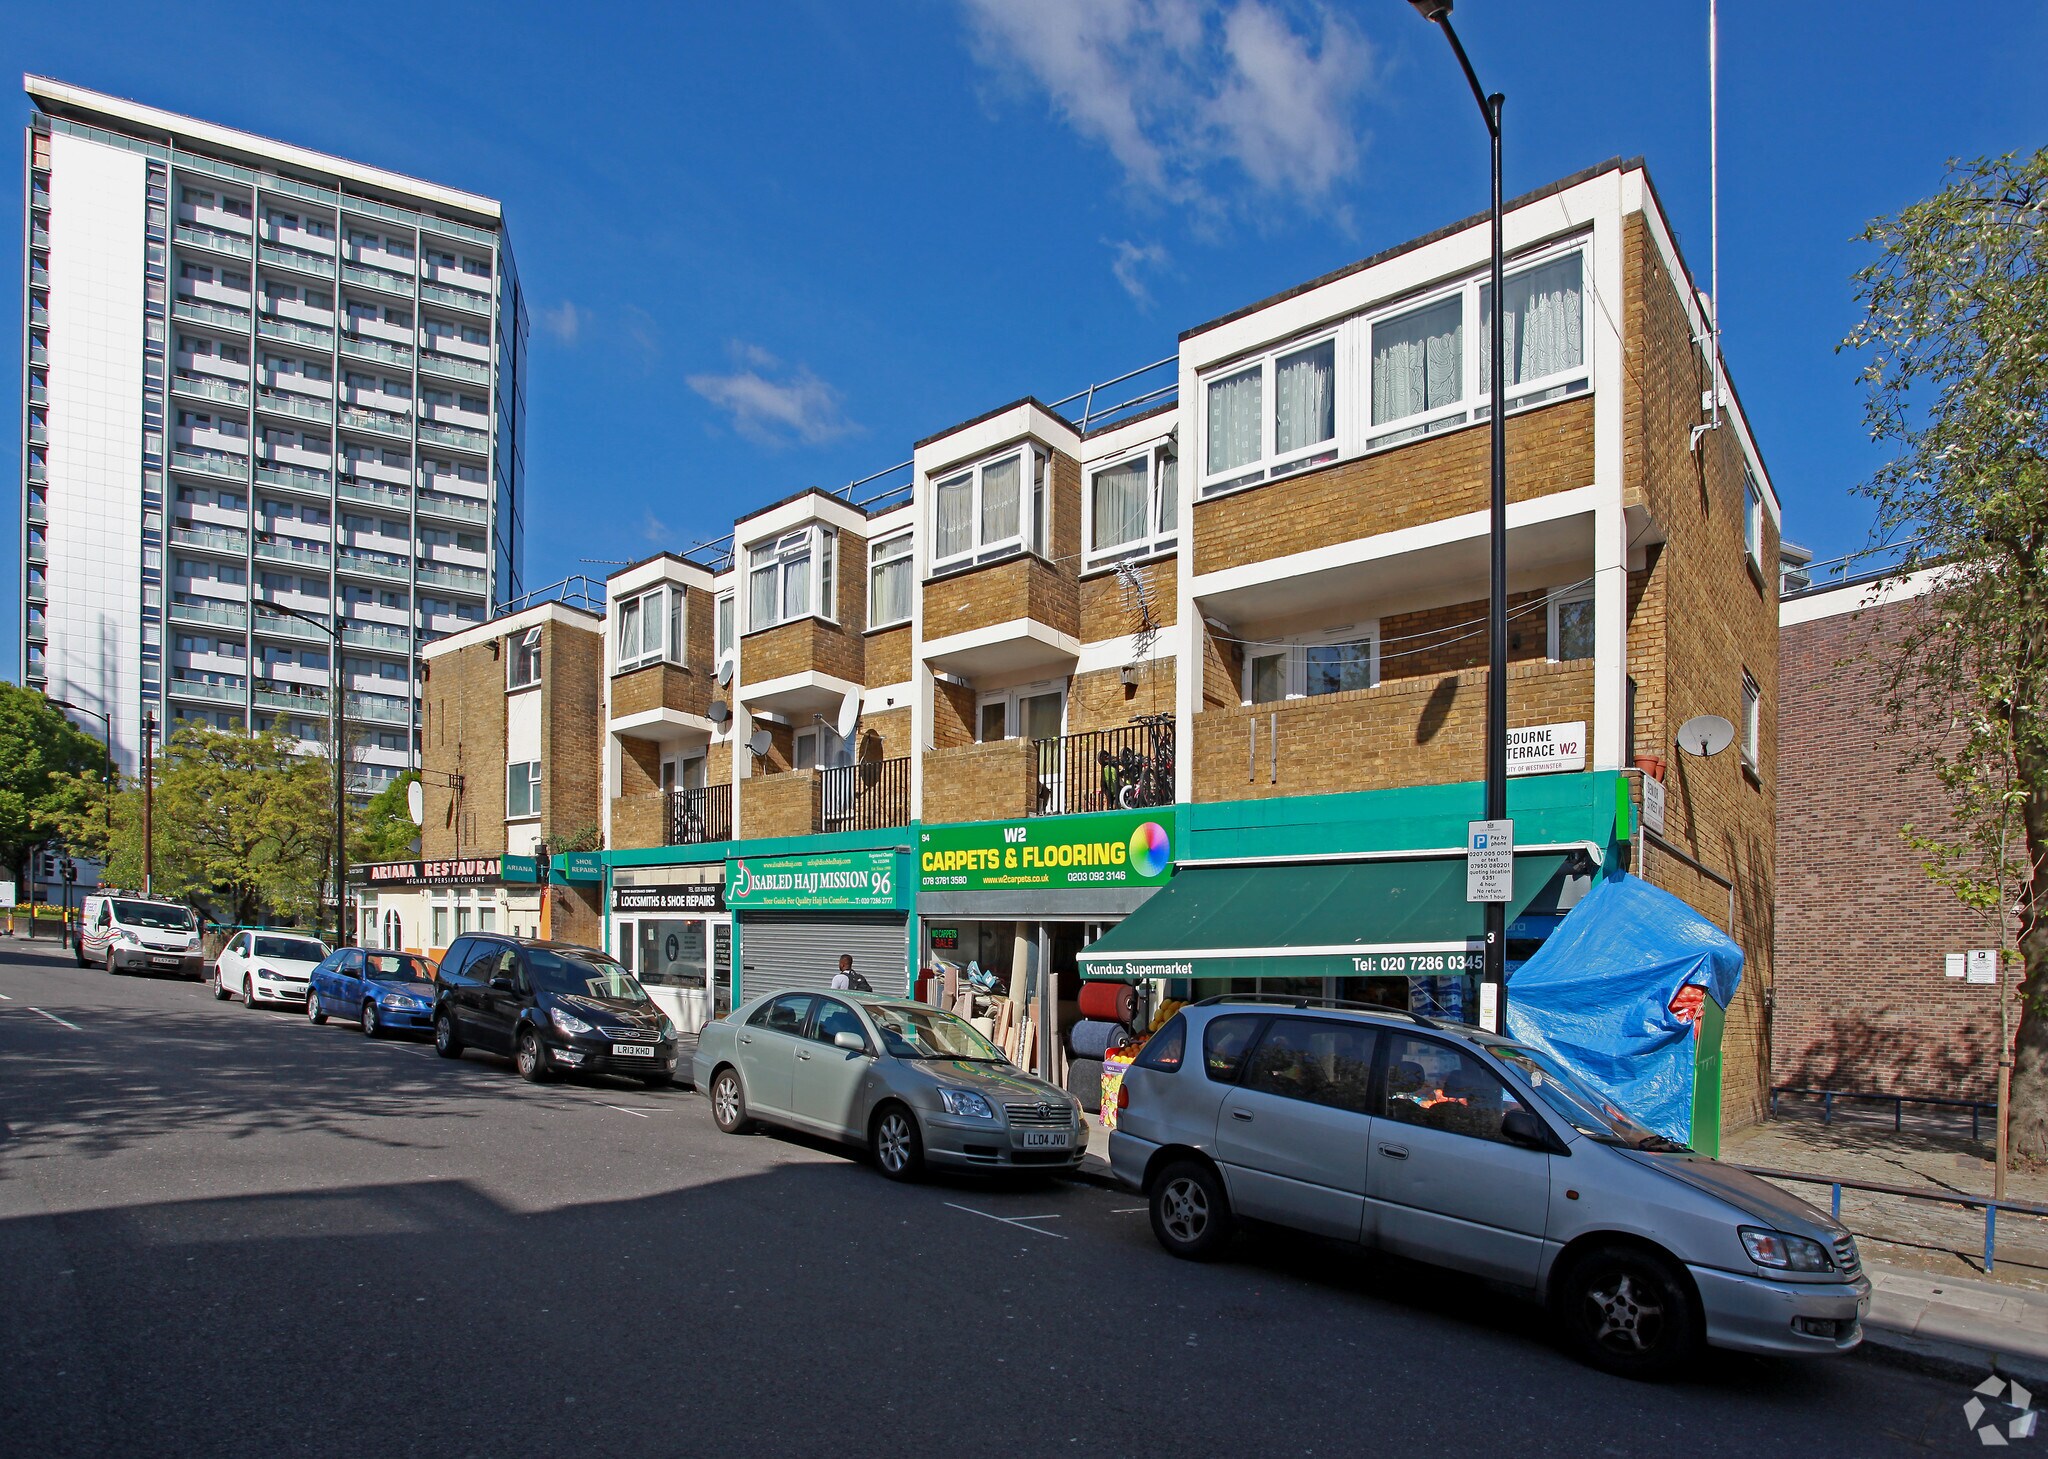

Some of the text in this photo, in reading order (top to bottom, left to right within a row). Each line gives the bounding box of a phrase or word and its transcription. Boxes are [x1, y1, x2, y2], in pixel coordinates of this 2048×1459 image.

[1506, 730, 1552, 745] BOURNE
[1506, 742, 1577, 759] TERRACE W2
[1525, 762, 1562, 771] WESTMINSTER
[921, 834, 930, 842] 94
[1003, 827, 1027, 843] W2
[921, 841, 1126, 872] CARPETS & FLOORING
[371, 864, 416, 880] ARIANA
[506, 864, 533, 872] ARIANA
[794, 873, 818, 893] HAJJ
[819, 871, 868, 888] MISSION
[922, 876, 967, 885] 078 3781 3580
[982, 874, 1049, 885] www.w2carpets.co.uk
[1067, 871, 1126, 882] 0203 092 3146
[872, 872, 890, 894] 96
[621, 896, 660, 907] LOCKSMITHS
[660, 896, 666, 906] &
[667, 895, 685, 906] SHOE
[686, 894, 716, 906] REPAIRS
[795, 896, 811, 905] Quality
[812, 896, 822, 905] Hajj
[935, 938, 953, 948] SALE
[1487, 933, 1495, 943] 3
[1352, 955, 1483, 970] Tel: 020 7286 0345
[1086, 962, 1192, 977] Kunduz Supermarket
[618, 1046, 634, 1054] LR13
[1028, 1134, 1048, 1145] LL04
